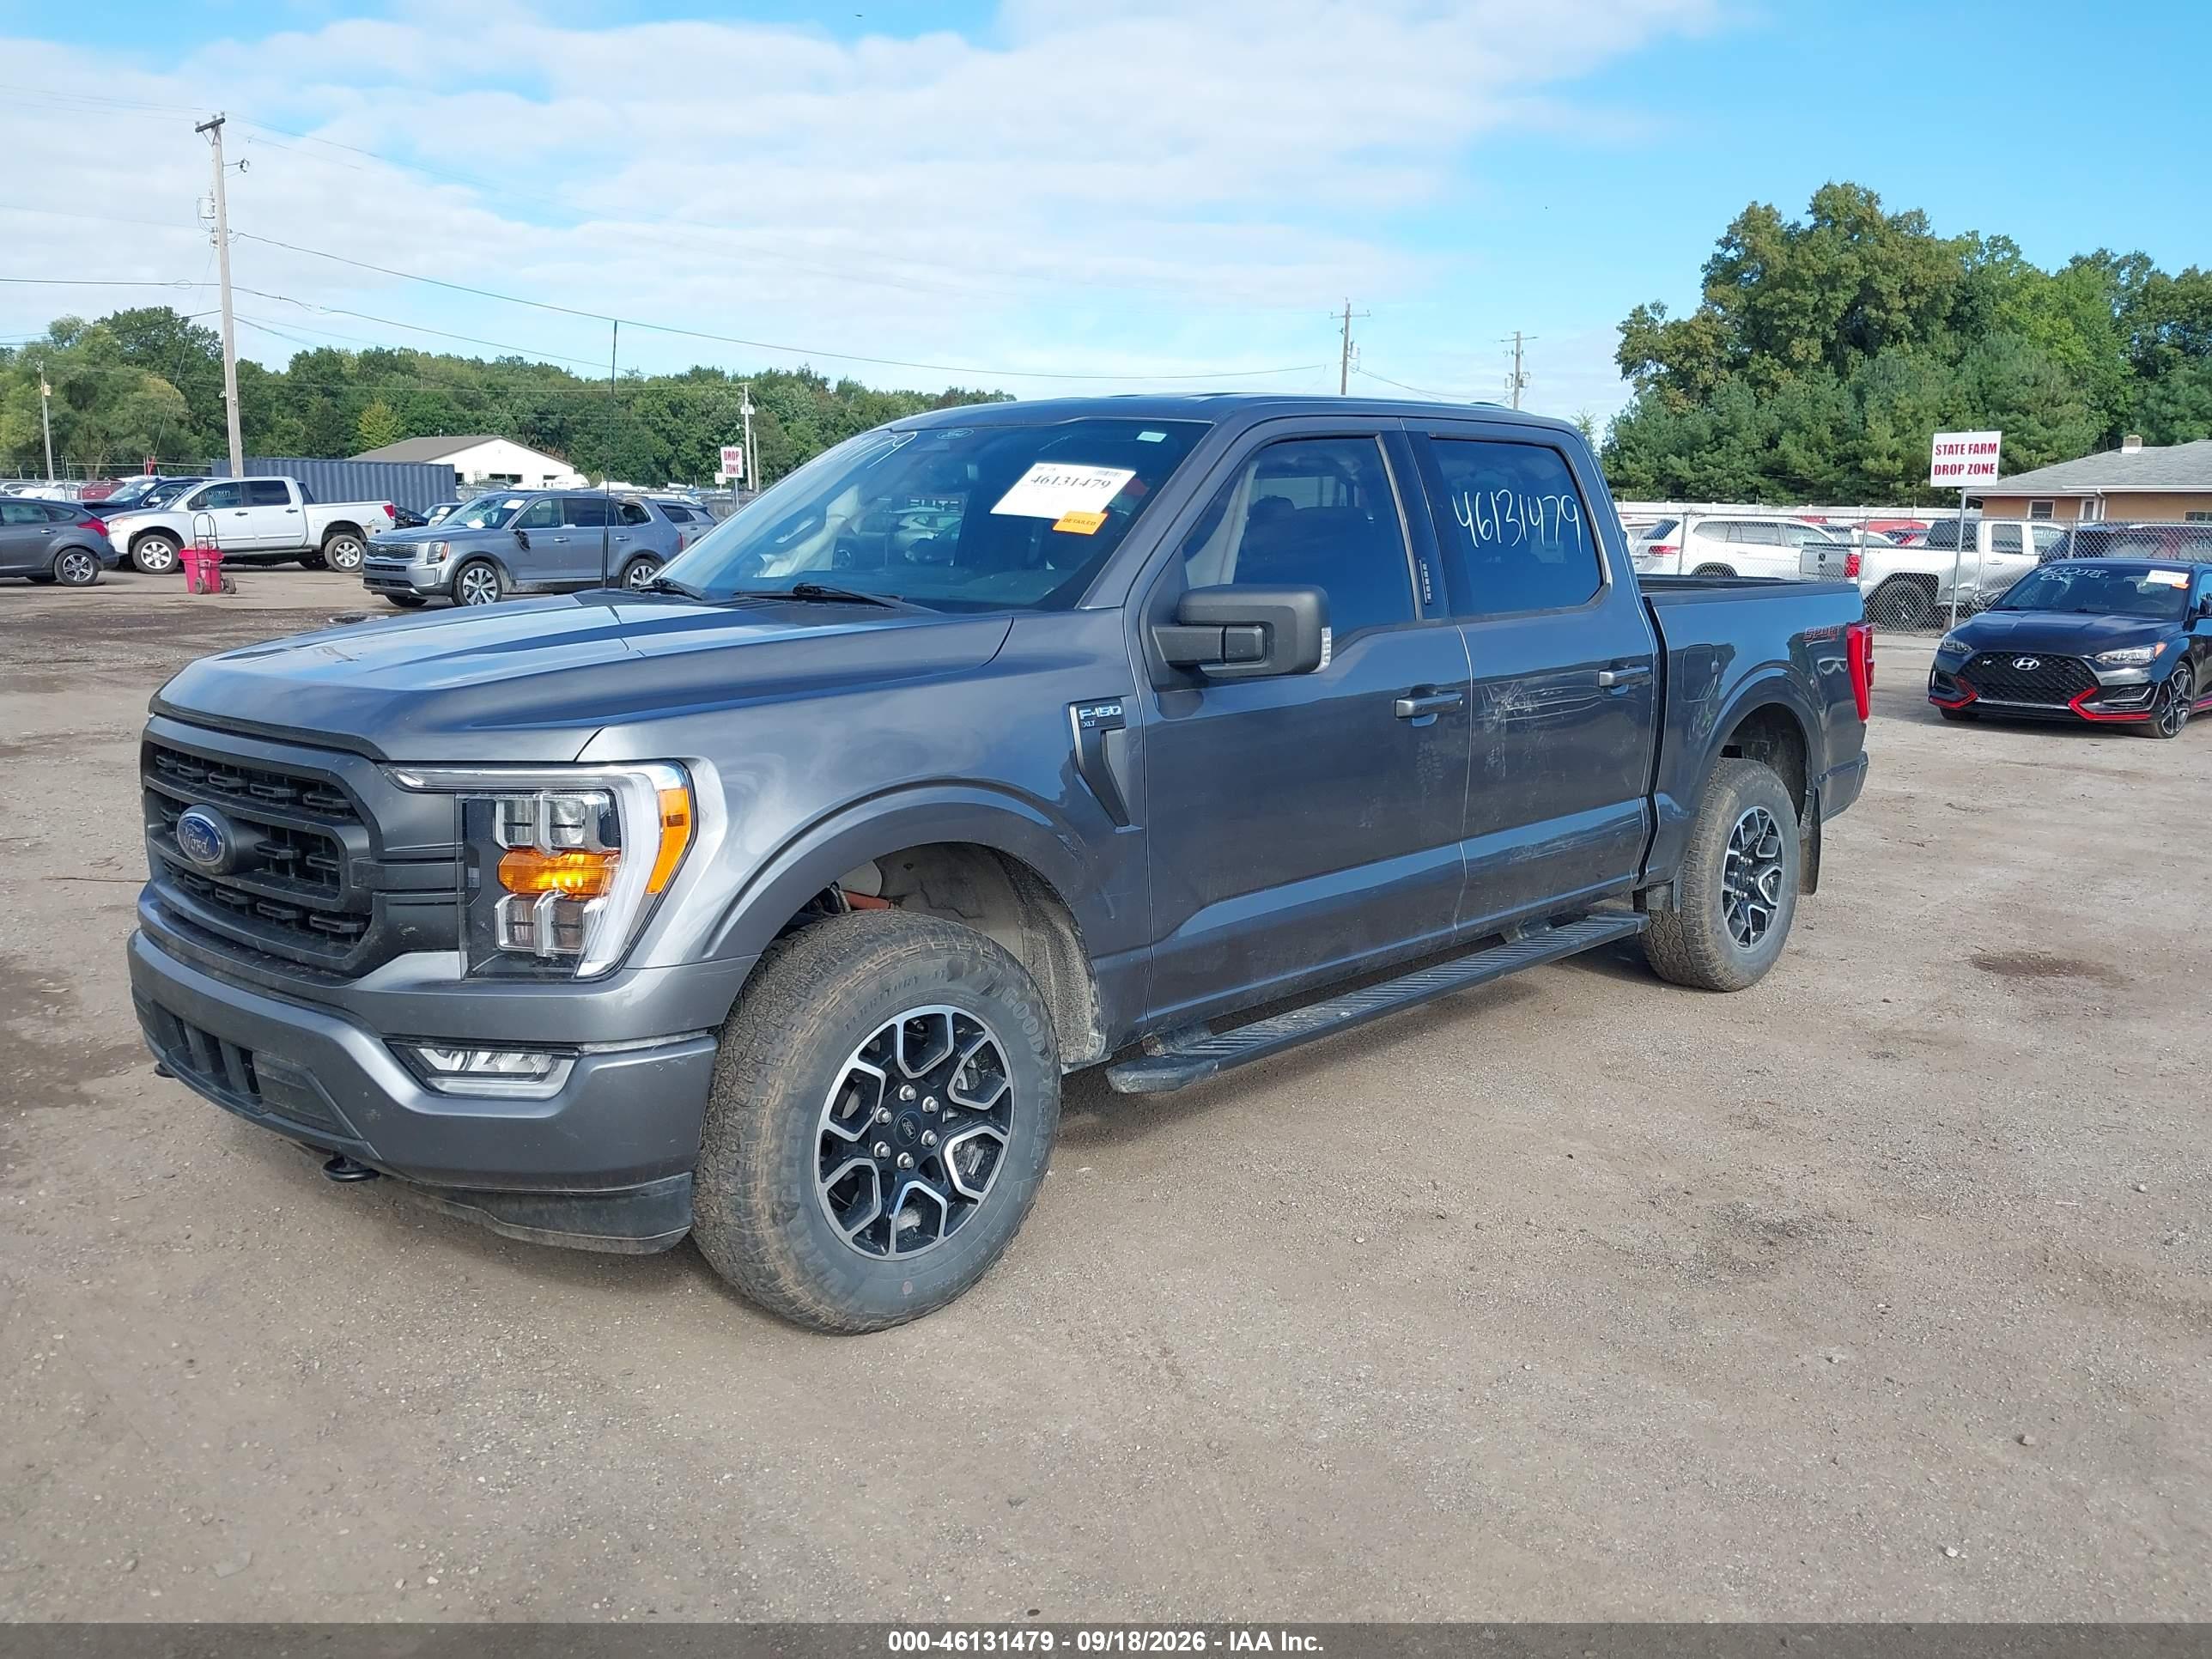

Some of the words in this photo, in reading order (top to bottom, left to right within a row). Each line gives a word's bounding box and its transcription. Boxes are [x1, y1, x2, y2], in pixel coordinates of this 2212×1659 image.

[724, 451, 739, 461] DROP
[1936, 444, 1966, 456] STATE
[1968, 443, 1997, 455] FARM
[726, 464, 739, 474] ZONE
[1934, 464, 1965, 476] DROP
[1967, 463, 1996, 475] ZONE
[1030, 475, 1111, 489] 46131479
[1062, 517, 1097, 526] DETAILED
[1451, 489, 1583, 555] 46131479
[1079, 705, 1122, 720] F-150
[183, 823, 210, 854] Ford
